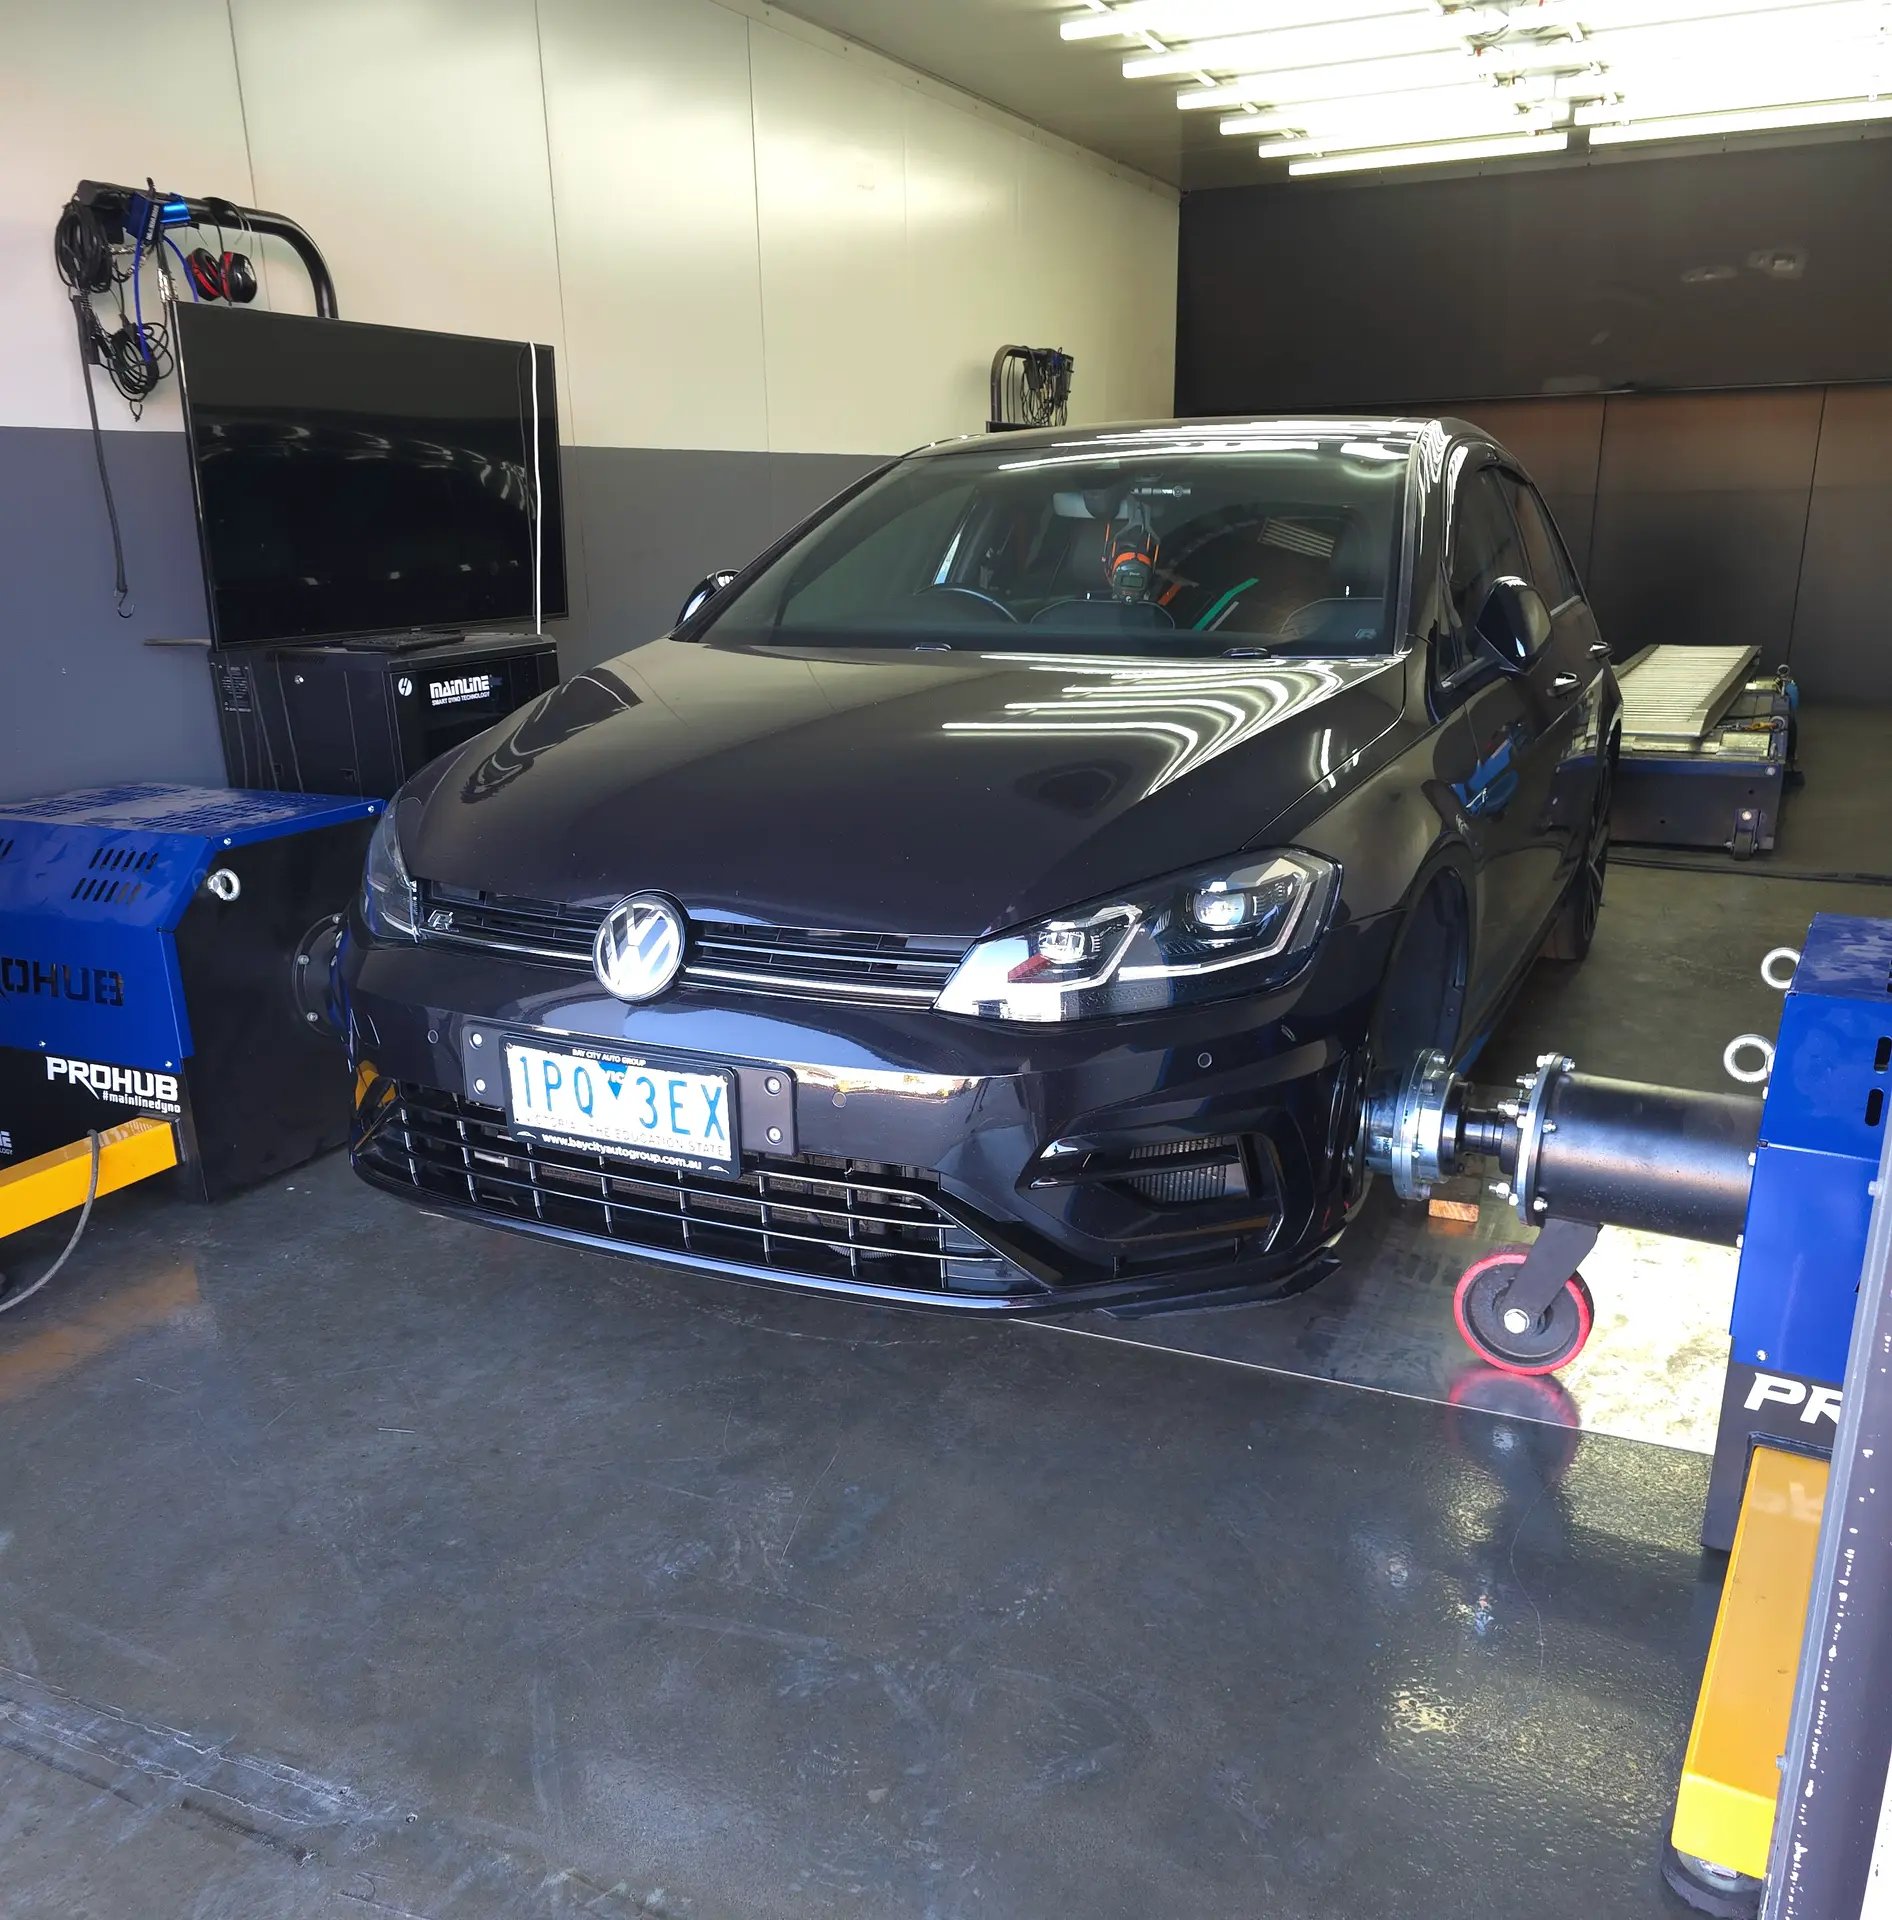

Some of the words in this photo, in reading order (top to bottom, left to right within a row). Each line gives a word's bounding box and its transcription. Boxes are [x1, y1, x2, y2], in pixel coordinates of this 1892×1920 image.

[431, 697, 448, 706] SMART
[461, 691, 490, 702] TECHNOLOGY
[0, 957, 124, 1006] OHUB
[572, 1048, 586, 1057] BAY
[586, 1051, 602, 1060] CITY
[602, 1053, 622, 1063] AUTO
[622, 1056, 647, 1067] GROUP
[45, 1056, 179, 1101] PROHUB
[102, 1090, 181, 1113] #mainlinedyno
[520, 1056, 594, 1118] 1PQ
[636, 1076, 726, 1141] 3EX
[541, 1132, 703, 1170] www.baycityautogroup.com.au
[688, 1140, 725, 1157] STATE
